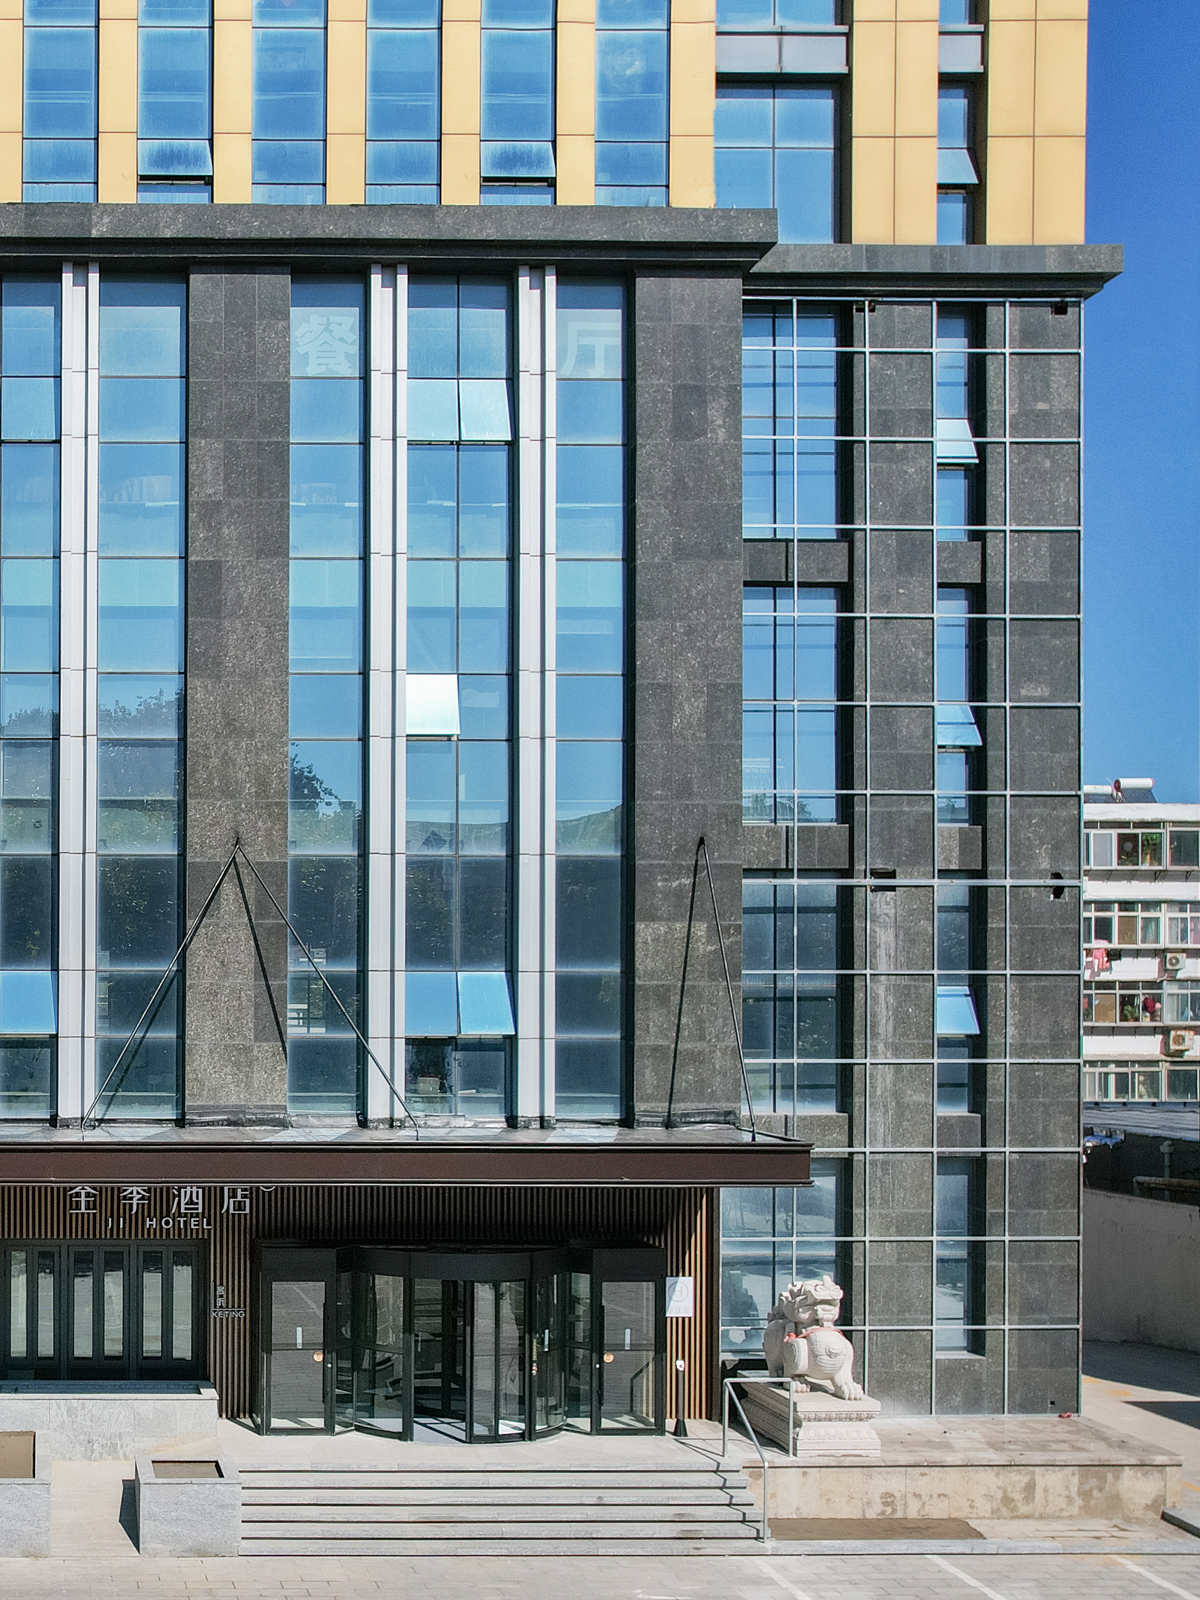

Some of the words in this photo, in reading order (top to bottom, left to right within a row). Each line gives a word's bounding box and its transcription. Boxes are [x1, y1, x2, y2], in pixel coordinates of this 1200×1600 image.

[295, 313, 623, 378] 餐厅
[67, 1185, 251, 1215] 全季酒店
[107, 1217, 125, 1229] JI
[146, 1217, 212, 1229] HOTEL
[212, 1310, 246, 1318] KETING
